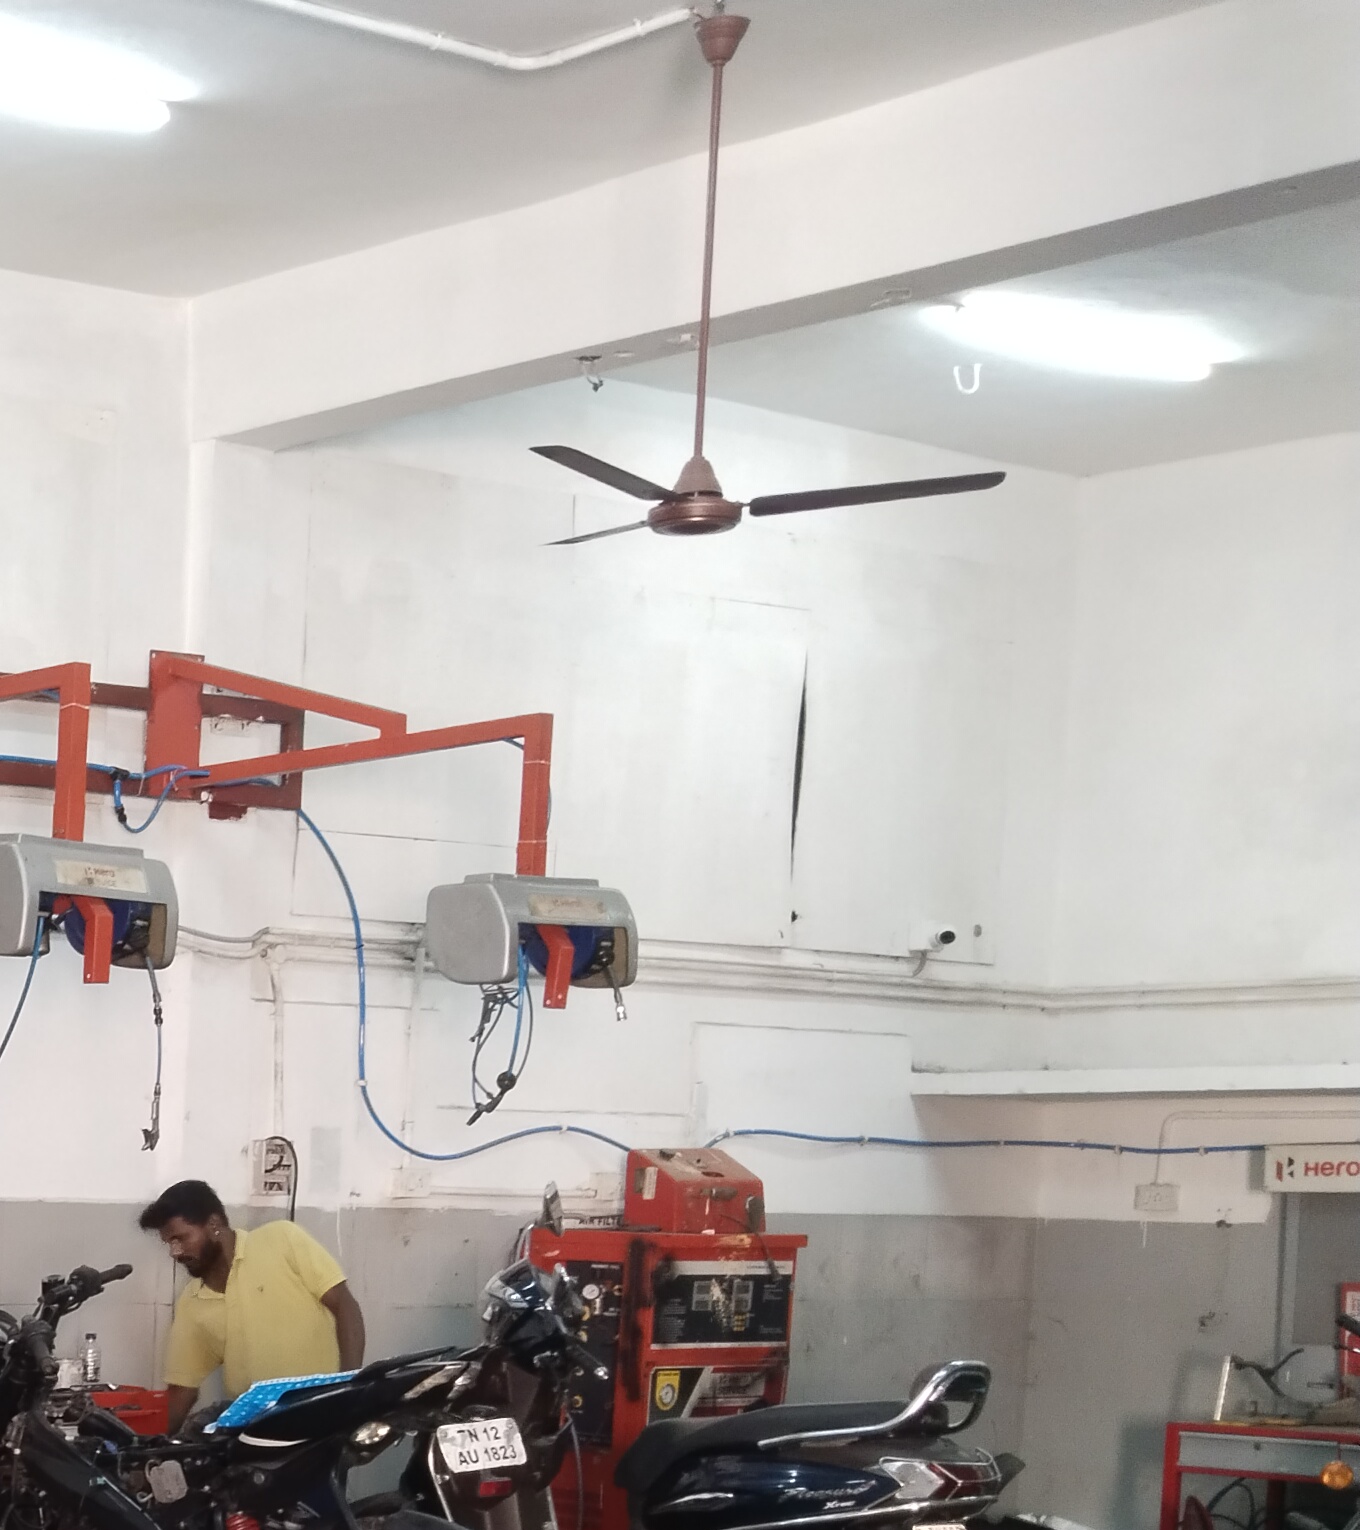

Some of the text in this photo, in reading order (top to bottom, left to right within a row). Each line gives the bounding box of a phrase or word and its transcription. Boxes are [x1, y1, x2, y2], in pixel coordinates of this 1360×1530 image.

[1303, 1160, 1360, 1177] Hero
[483, 1426, 502, 1442] 12
[457, 1444, 518, 1467] AU 1823
